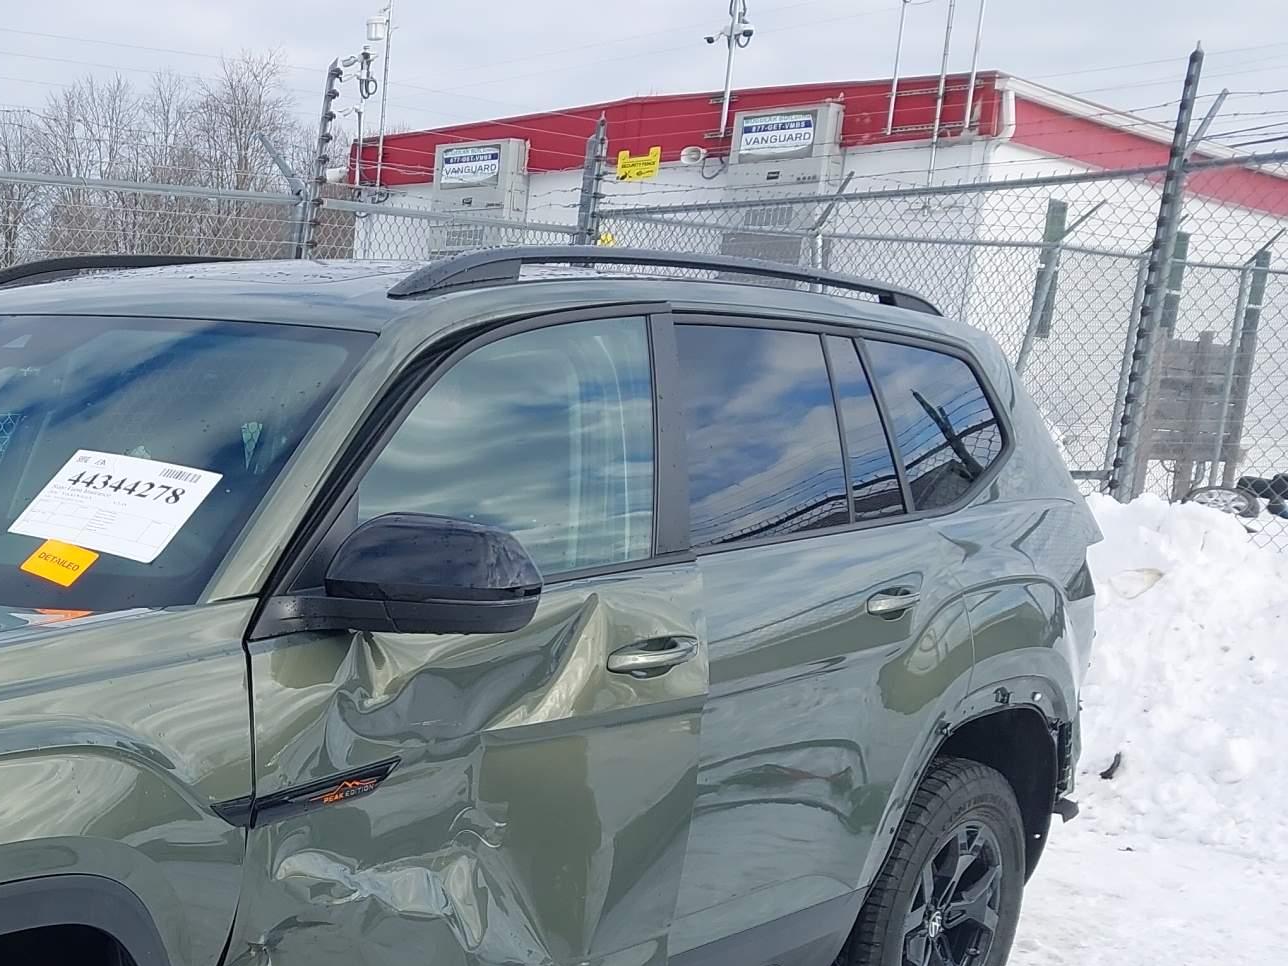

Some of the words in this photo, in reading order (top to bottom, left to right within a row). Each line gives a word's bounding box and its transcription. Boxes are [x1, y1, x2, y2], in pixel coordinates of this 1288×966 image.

[751, 120, 806, 132] 877-GET-VMBS
[745, 131, 812, 146] VANGUARD
[444, 163, 497, 176] VANGUARD
[67, 470, 186, 505] 44344278
[38, 552, 80, 571] DETAILED
[323, 792, 344, 803] PEAK
[345, 784, 374, 797] EDITION
